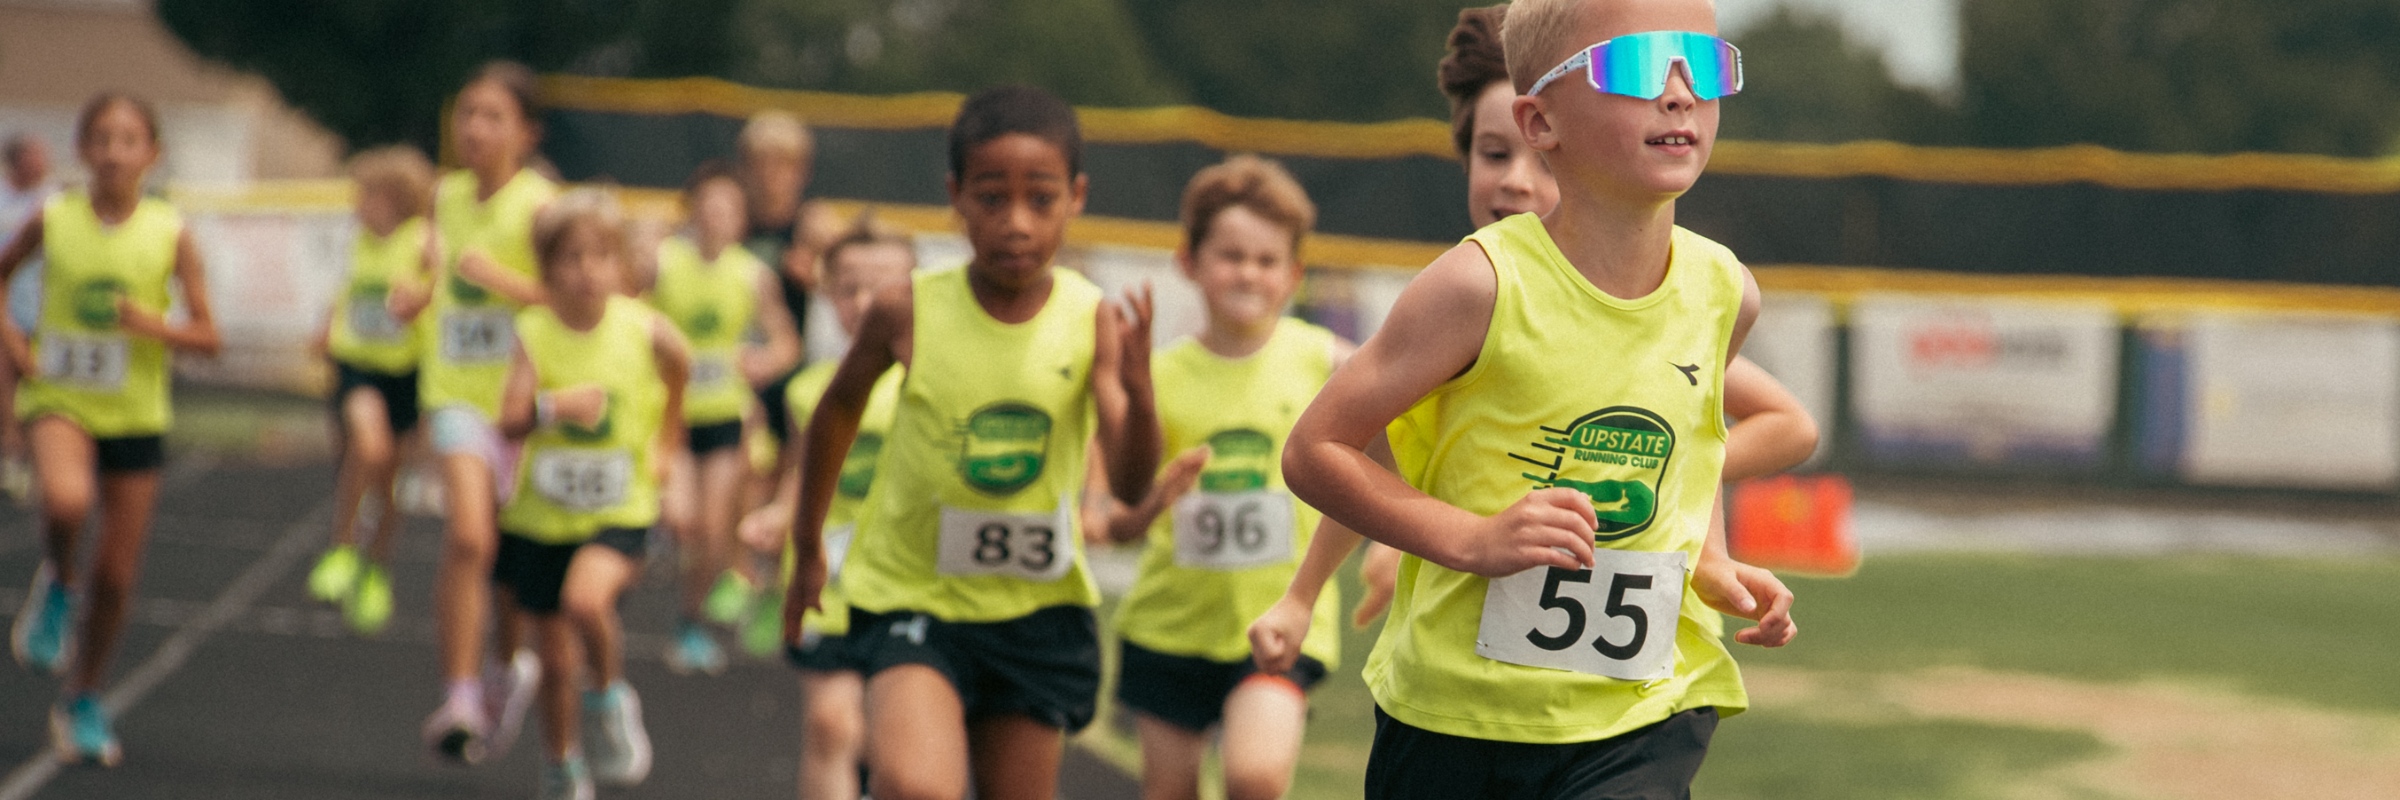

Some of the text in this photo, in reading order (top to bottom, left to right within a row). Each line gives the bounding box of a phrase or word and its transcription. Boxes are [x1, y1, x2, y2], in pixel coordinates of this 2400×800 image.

[1574, 449, 1659, 469] RUNNING CLUB
[1580, 427, 1666, 455] UPSTATE
[973, 521, 1055, 574] 83
[1195, 501, 1267, 555] 96
[1525, 566, 1653, 661] 55
